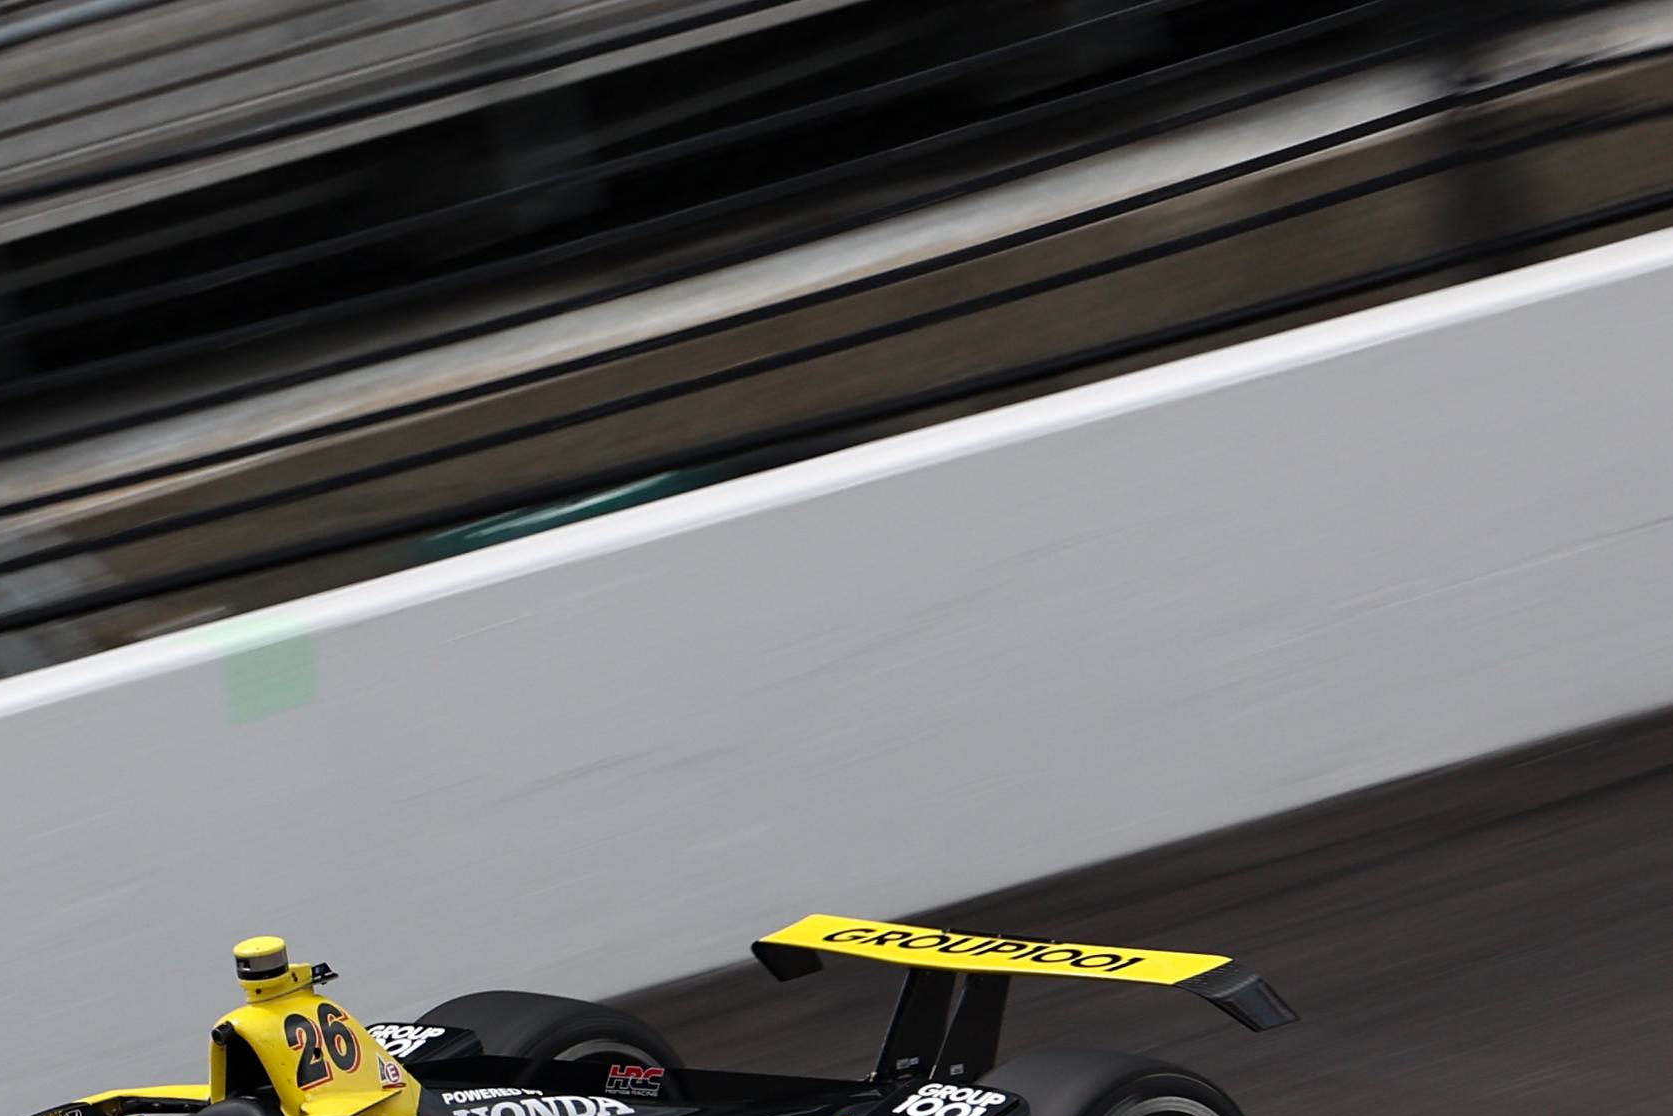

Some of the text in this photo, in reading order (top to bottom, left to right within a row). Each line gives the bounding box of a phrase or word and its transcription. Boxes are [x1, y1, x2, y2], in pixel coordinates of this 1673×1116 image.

[823, 928, 1144, 972] GROUP1001
[284, 1003, 361, 1091] 26
[442, 1087, 522, 1105] POWERED
[917, 1083, 1007, 1107] GROUP
